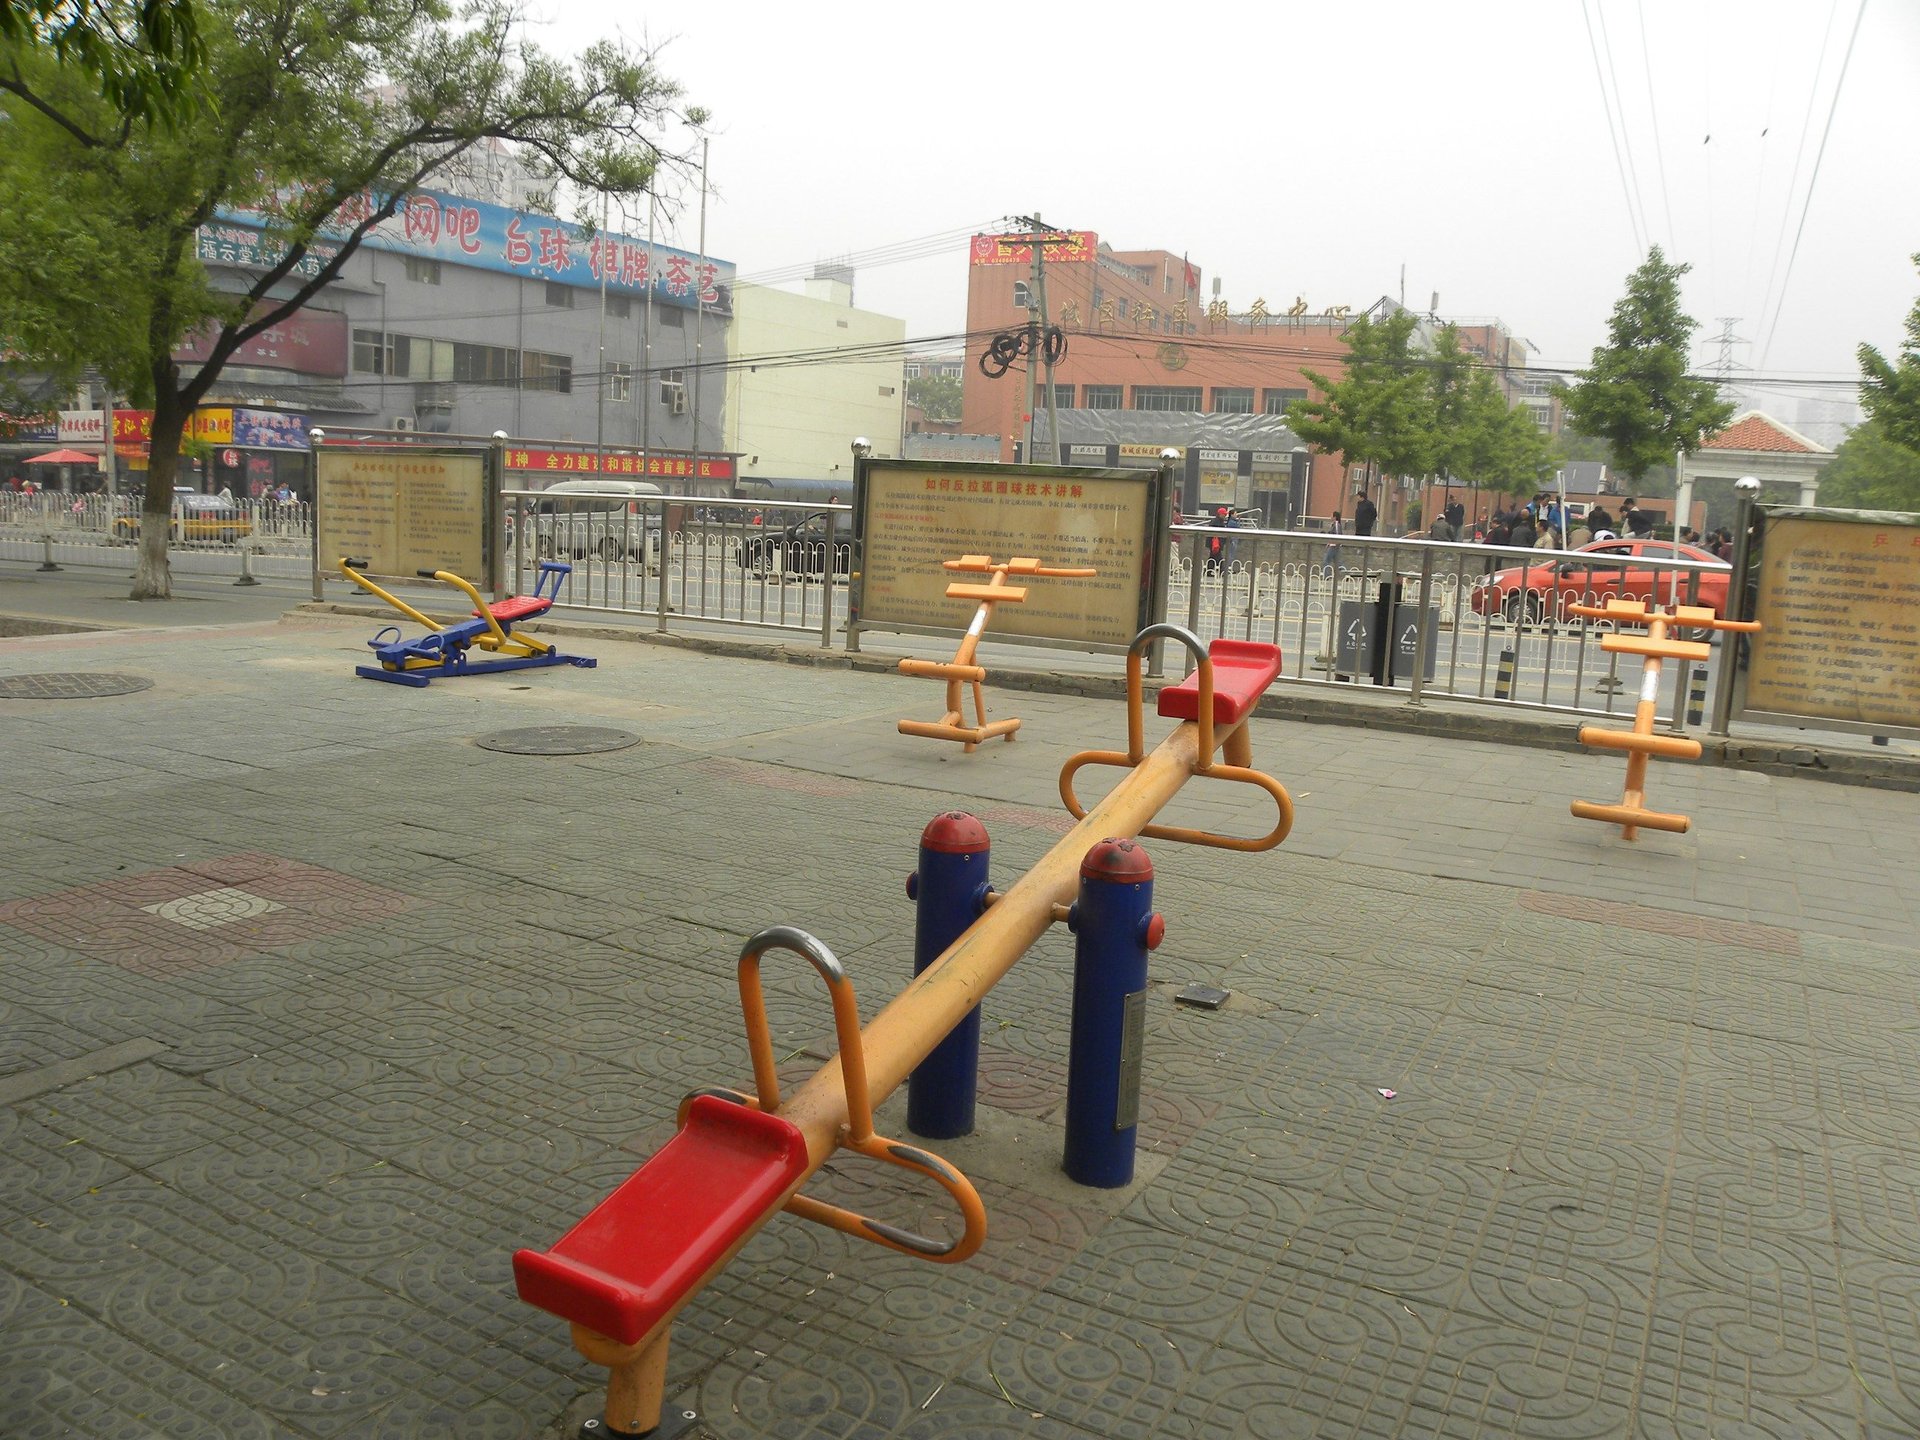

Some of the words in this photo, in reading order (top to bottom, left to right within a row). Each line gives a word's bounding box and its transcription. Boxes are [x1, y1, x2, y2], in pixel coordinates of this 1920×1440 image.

[404, 194, 482, 254] 网吧
[505, 216, 573, 272] 台球
[589, 236, 651, 289] 棋牌
[665, 254, 721, 303] 茶艺
[1034, 296, 1351, 329] 城区社区服务中心
[925, 478, 1083, 498] 如何反拉弧圈球技术讲解
